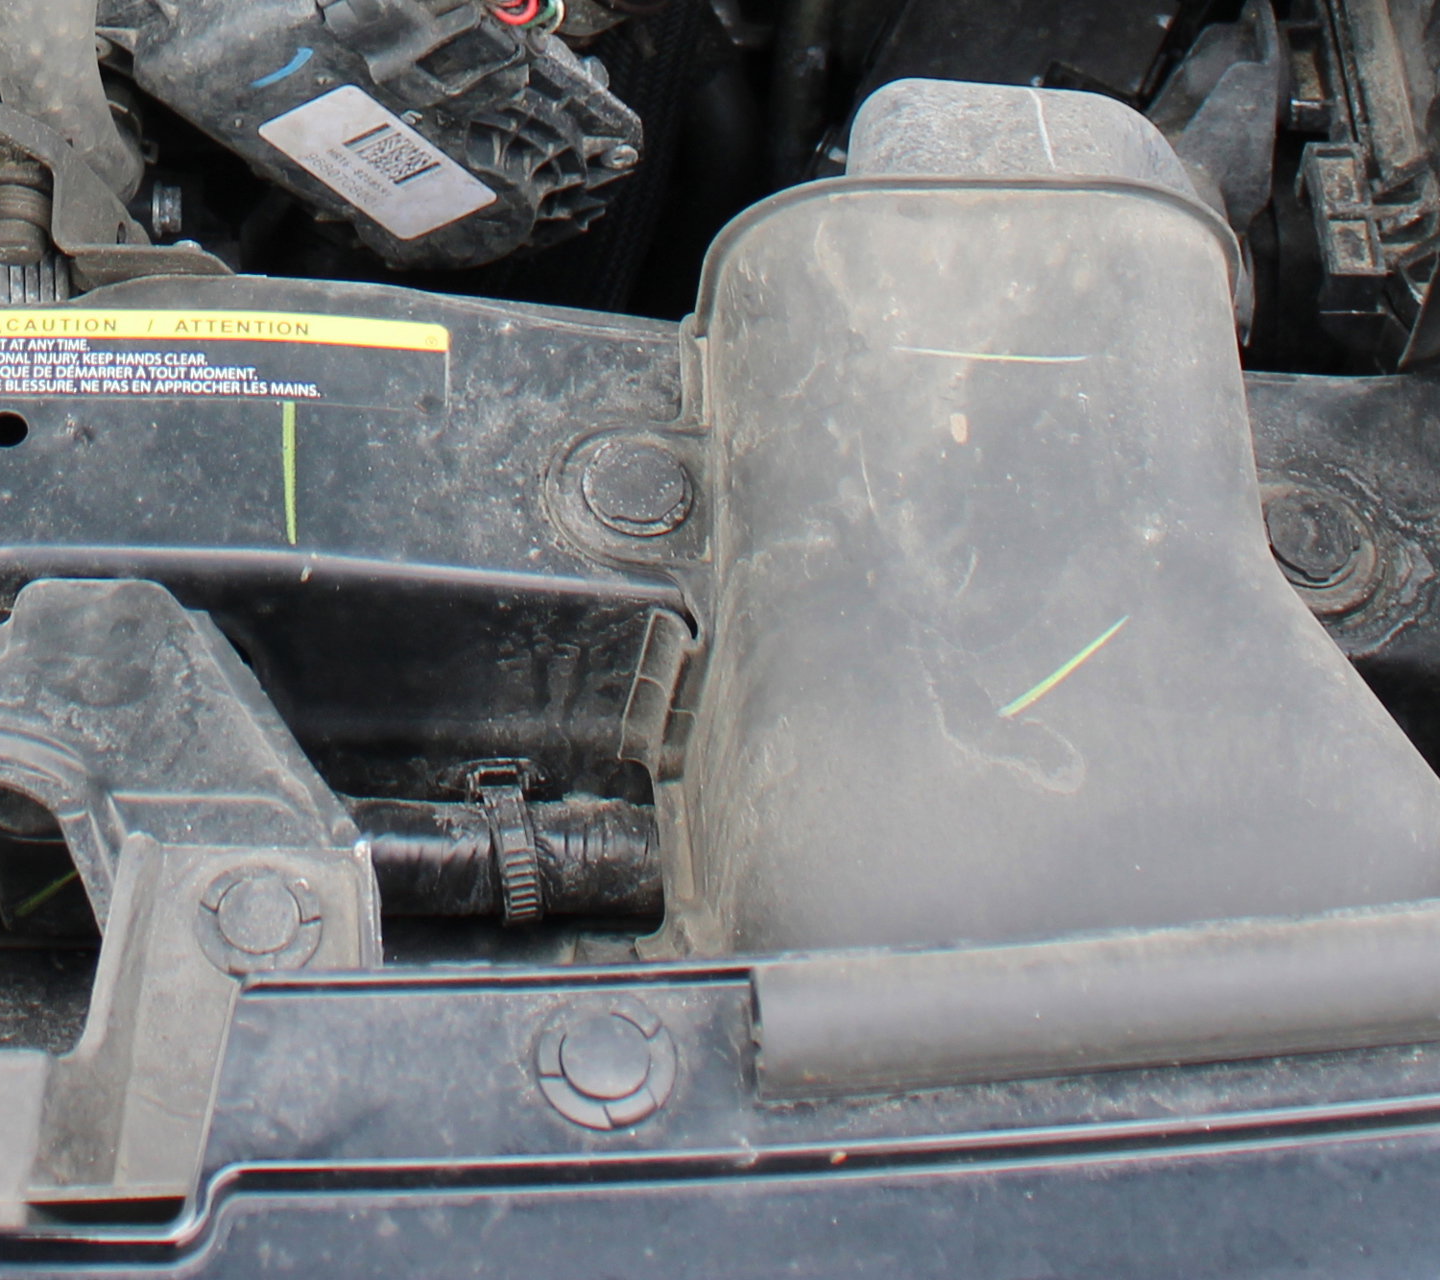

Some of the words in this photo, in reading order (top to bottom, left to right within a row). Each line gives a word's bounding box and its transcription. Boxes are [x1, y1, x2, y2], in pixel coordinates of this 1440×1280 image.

[6, 319, 117, 332] CAUTION
[175, 319, 310, 336] ATTENTION
[10, 338, 25, 351] AT
[27, 338, 55, 351] ANY
[53, 338, 91, 352] TIME.
[33, 352, 80, 366] INJURY,
[82, 353, 114, 365] KEEP
[116, 353, 162, 366] HANDS
[164, 352, 208, 366] CLEAR.
[33, 366, 53, 379] DE
[55, 363, 133, 379] DÉMARRER
[135, 364, 148, 379] À
[149, 367, 186, 380] TOUT
[189, 366, 258, 381] MOMENT.
[4, 379, 77, 394] BLESSURE,
[80, 380, 99, 393] NE
[102, 380, 128, 393] PAS
[132, 381, 151, 393] EN
[154, 380, 240, 394] APPROCHER
[242, 381, 268, 395] LES
[271, 382, 321, 398] MAINS.
